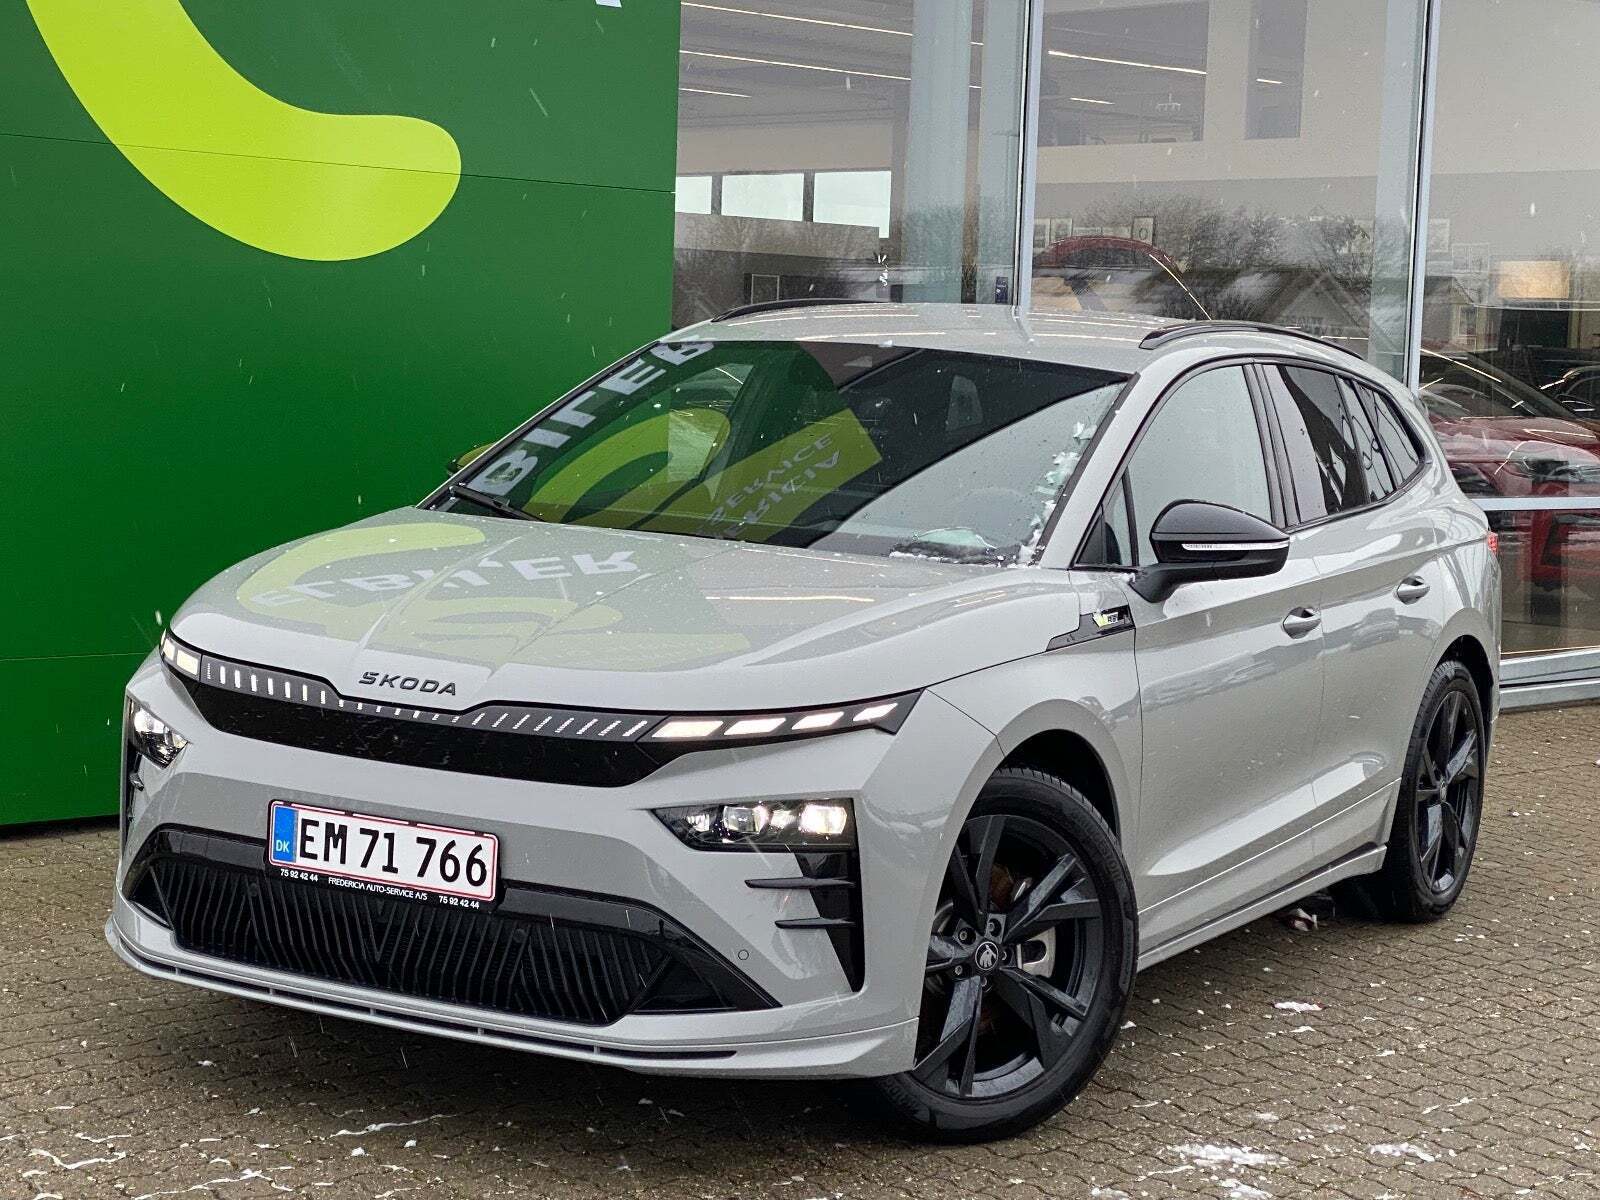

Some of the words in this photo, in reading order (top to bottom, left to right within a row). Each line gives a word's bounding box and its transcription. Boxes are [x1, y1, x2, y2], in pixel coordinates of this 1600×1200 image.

[276, 840, 290, 853] DK
[300, 818, 348, 864] EM
[359, 828, 399, 874] 71
[416, 836, 487, 886] 766
[280, 868, 289, 877] 75
[290, 870, 299, 879] 92
[299, 872, 309, 881] 42
[309, 873, 318, 882] 44
[328, 876, 366, 890] FREDERICIA
[366, 884, 414, 899] AUTO-SERVICE
[415, 891, 428, 900] A/S
[439, 895, 448, 904] 75
[449, 897, 459, 906] 92
[459, 899, 469, 908] 42
[470, 901, 479, 910] 44
